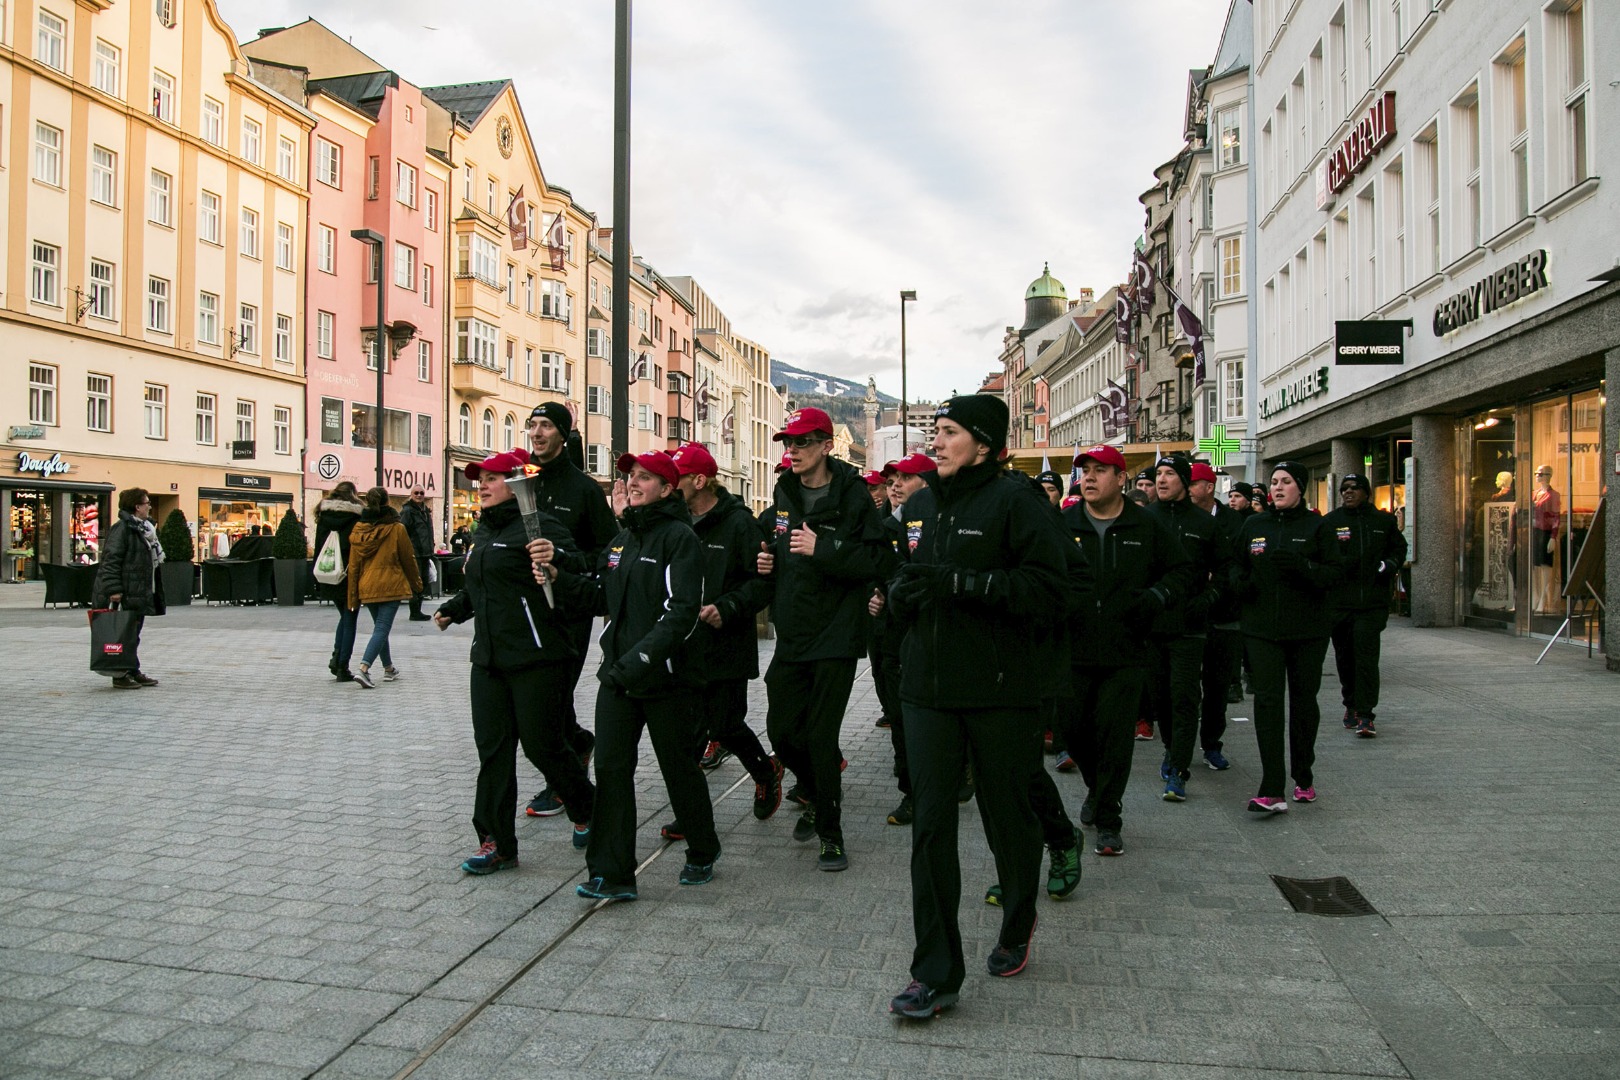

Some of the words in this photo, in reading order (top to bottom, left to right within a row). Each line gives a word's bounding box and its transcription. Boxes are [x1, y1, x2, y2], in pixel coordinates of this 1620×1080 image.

[1328, 91, 1390, 195] GENERALI
[1433, 281, 1481, 337] GERRY
[1481, 249, 1547, 314] WEBER
[1339, 346, 1368, 355] GERRY
[1369, 345, 1401, 354] WEBER
[1265, 389, 1284, 417] ANNA
[1284, 367, 1327, 408] APOTHEKE
[18, 452, 71, 478] Douglas
[242, 476, 260, 486] BONITA
[374, 466, 436, 491] YROLIA
[106, 644, 121, 652] mey
